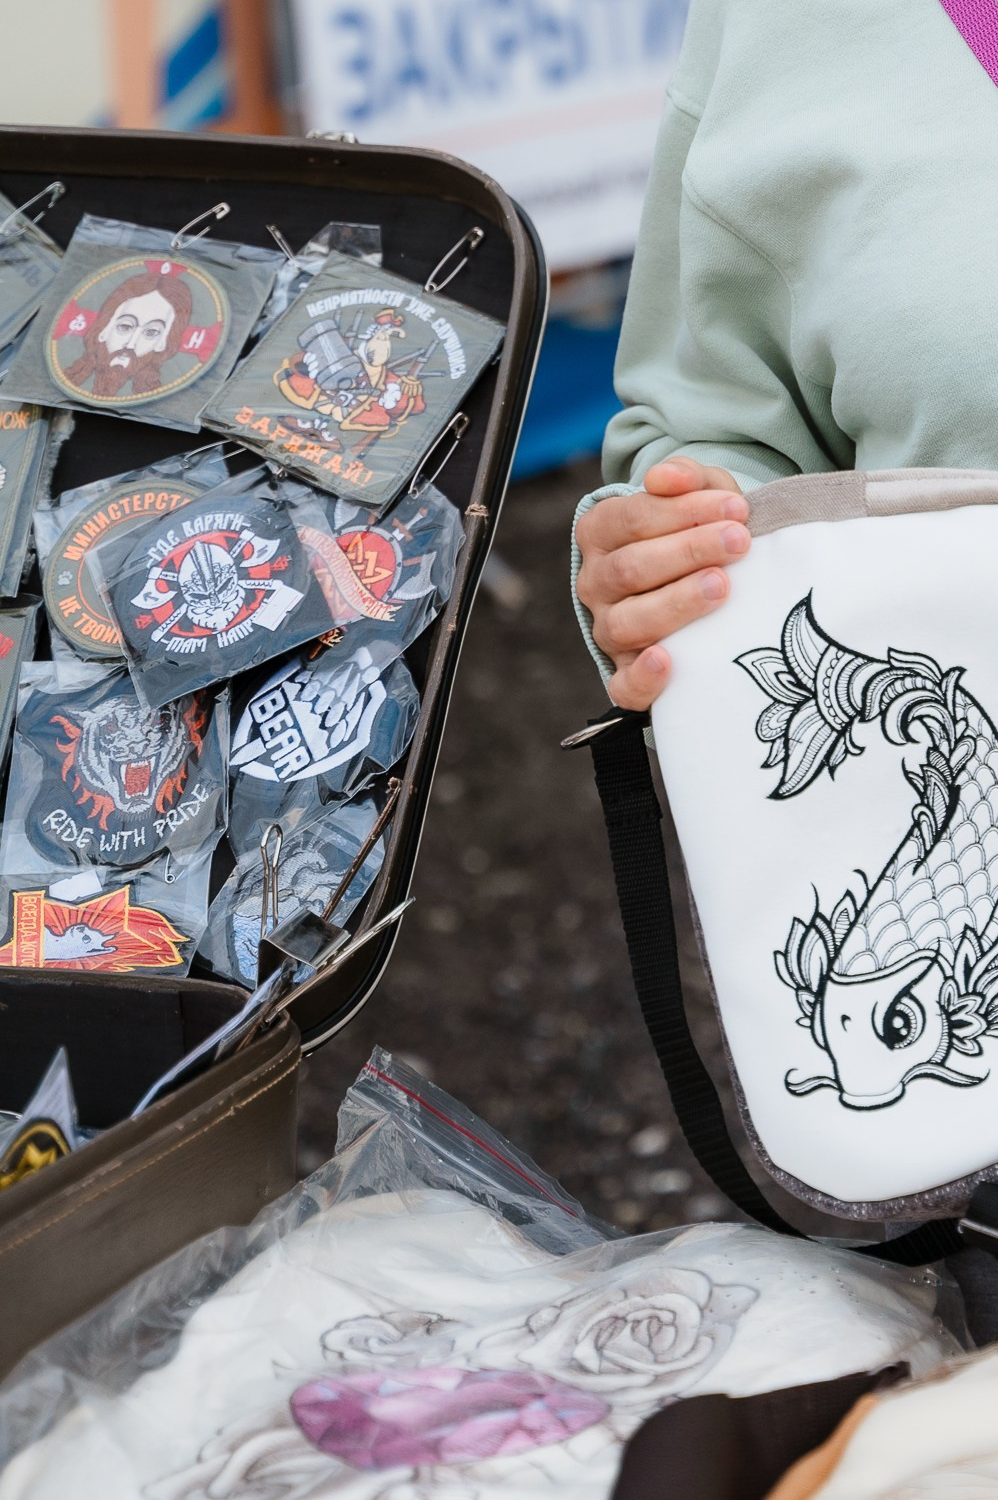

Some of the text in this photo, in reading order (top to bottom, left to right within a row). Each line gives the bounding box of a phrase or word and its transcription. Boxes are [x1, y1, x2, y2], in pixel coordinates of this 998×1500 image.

[306, 289, 403, 318] НЕПРИЯТНОСТИ
[59, 595, 81, 618] НЕ
[250, 689, 311, 779] BEAR
[42, 783, 210, 852] RIDE WITH PRIDE
